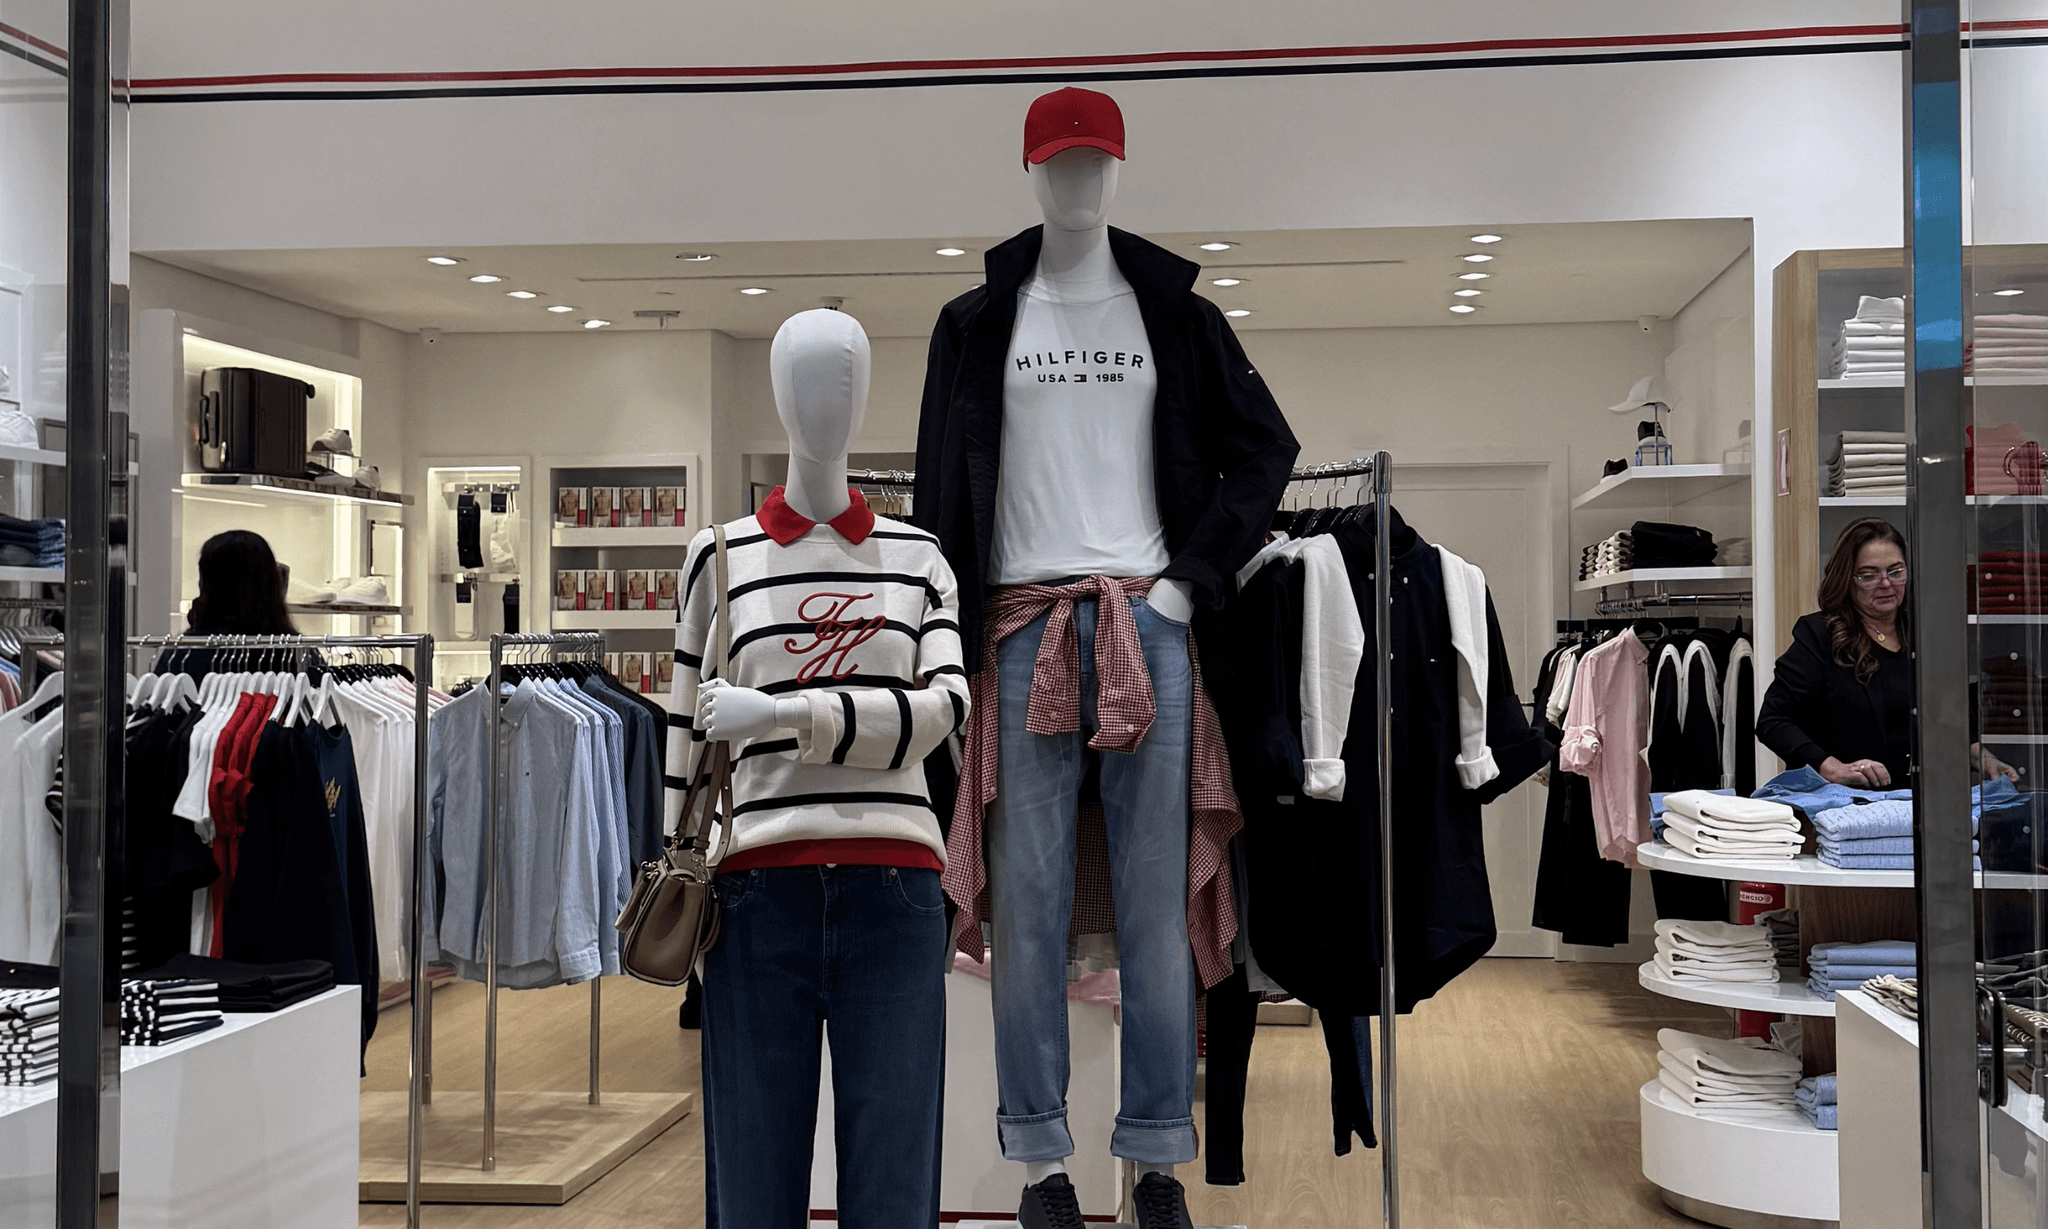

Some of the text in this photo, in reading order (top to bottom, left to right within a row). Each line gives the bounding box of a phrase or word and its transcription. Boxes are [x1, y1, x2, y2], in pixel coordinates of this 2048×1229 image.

[1016, 350, 1144, 371] HILFIGER
[1037, 373, 1124, 383] USA 1985
